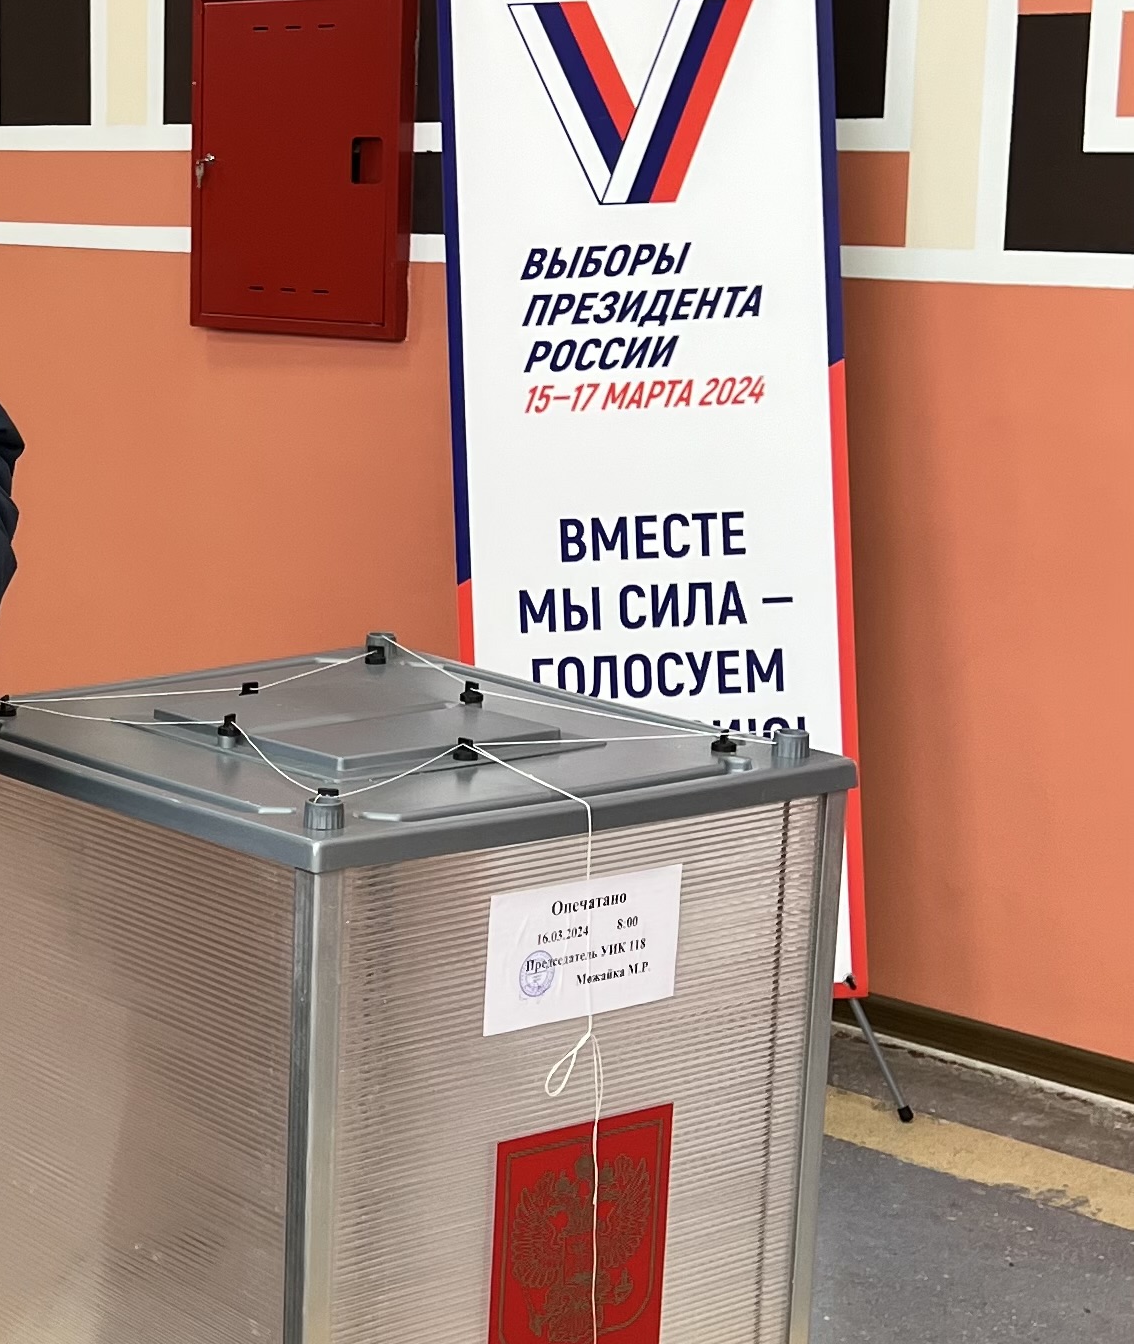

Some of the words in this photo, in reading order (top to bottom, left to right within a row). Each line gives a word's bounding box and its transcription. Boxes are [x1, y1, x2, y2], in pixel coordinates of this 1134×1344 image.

[520, 241, 692, 281] ВЫБОРЫ
[522, 284, 764, 328] ПРЕЗИДЕНТА
[523, 335, 680, 373] РОССИИ
[602, 378, 694, 410] МАРТА
[698, 375, 766, 406] 2024
[558, 510, 747, 563] ВМЕСТЕ
[518, 586, 601, 634] МЫ
[619, 580, 748, 630] СИЛА
[531, 647, 785, 699] ГОЛОСУЕМ
[551, 892, 627, 916] Опечатано
[537, 925, 590, 945] 16.03.2024
[616, 915, 639, 930] 8:00
[525, 950, 598, 973] Председатель
[601, 941, 626, 957] УИК
[629, 938, 646, 952] 118
